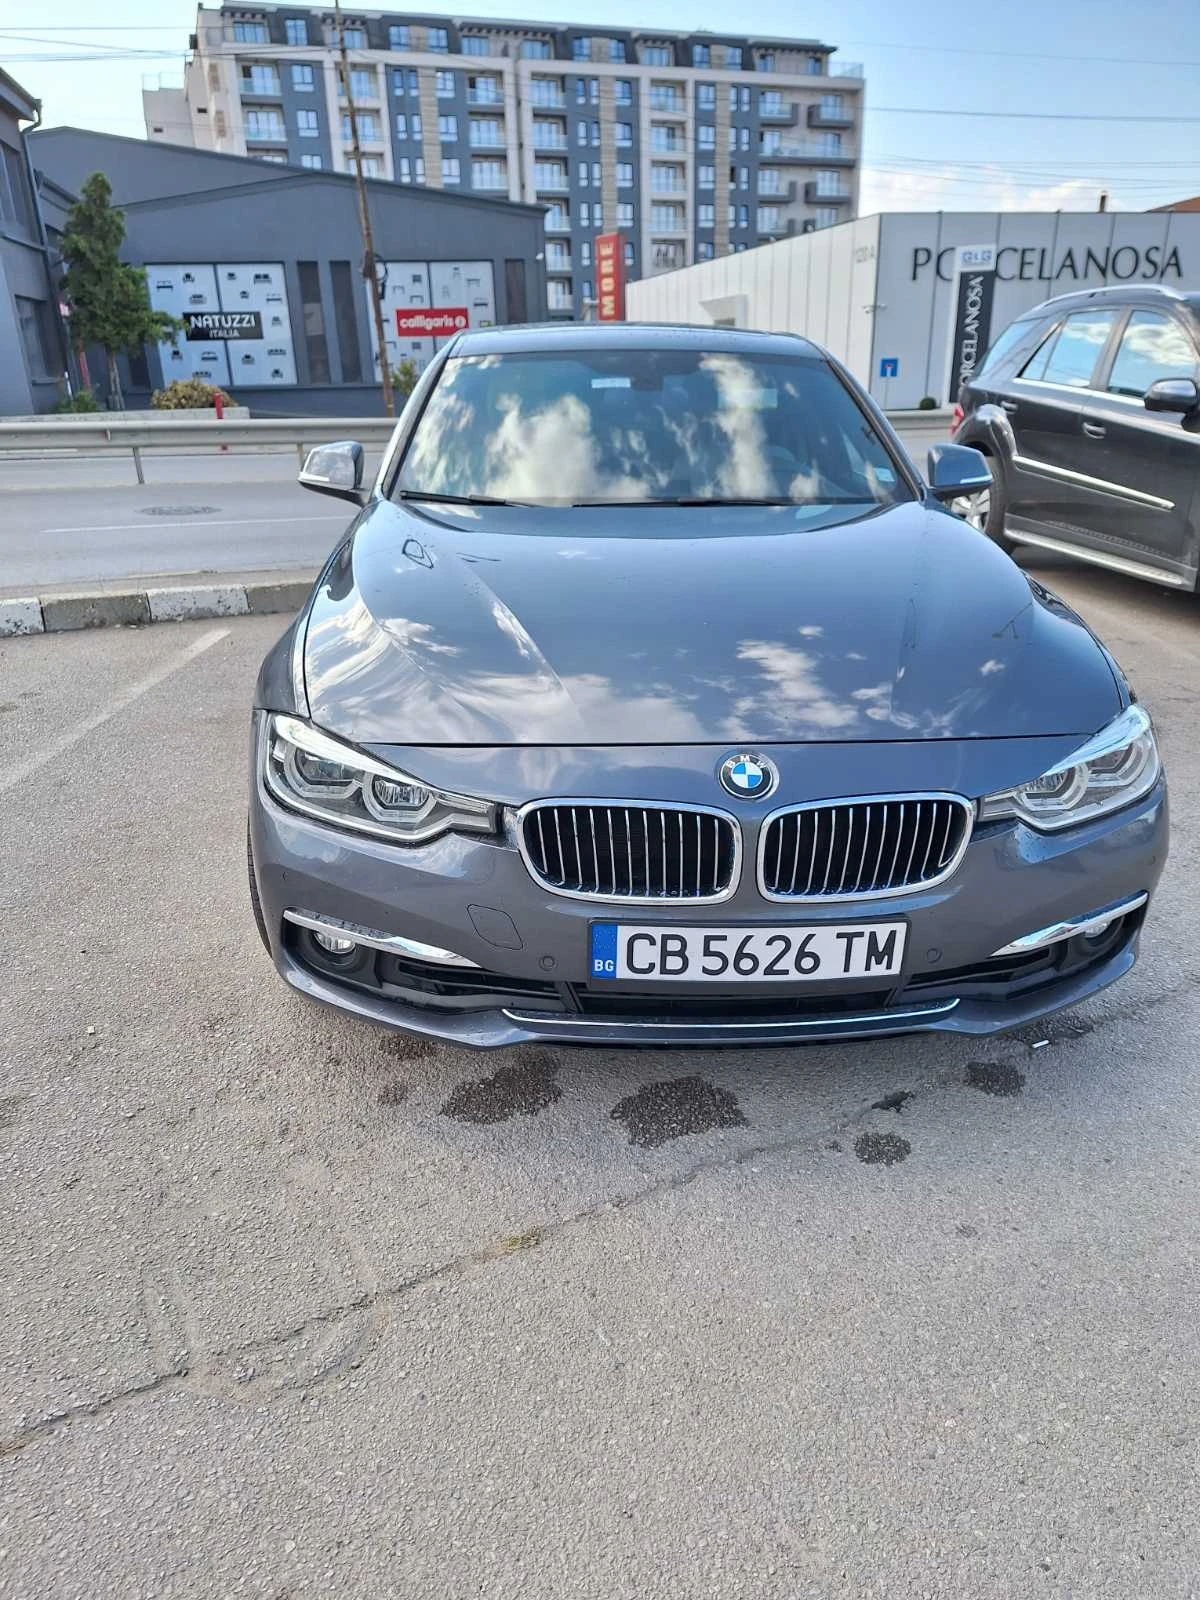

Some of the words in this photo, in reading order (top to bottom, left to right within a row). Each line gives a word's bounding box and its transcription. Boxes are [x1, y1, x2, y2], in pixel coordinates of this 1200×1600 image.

[911, 246, 1183, 281] POCELANOSA
[600, 242, 616, 317] MORE
[190, 314, 256, 329] NATUZZI
[400, 314, 454, 331] calligaris
[209, 328, 240, 338] ITALIA
[726, 755, 768, 769] BMW
[626, 932, 690, 976] CB
[701, 933, 821, 976] 5626
[835, 929, 897, 973] TM
[594, 959, 615, 972] BG
